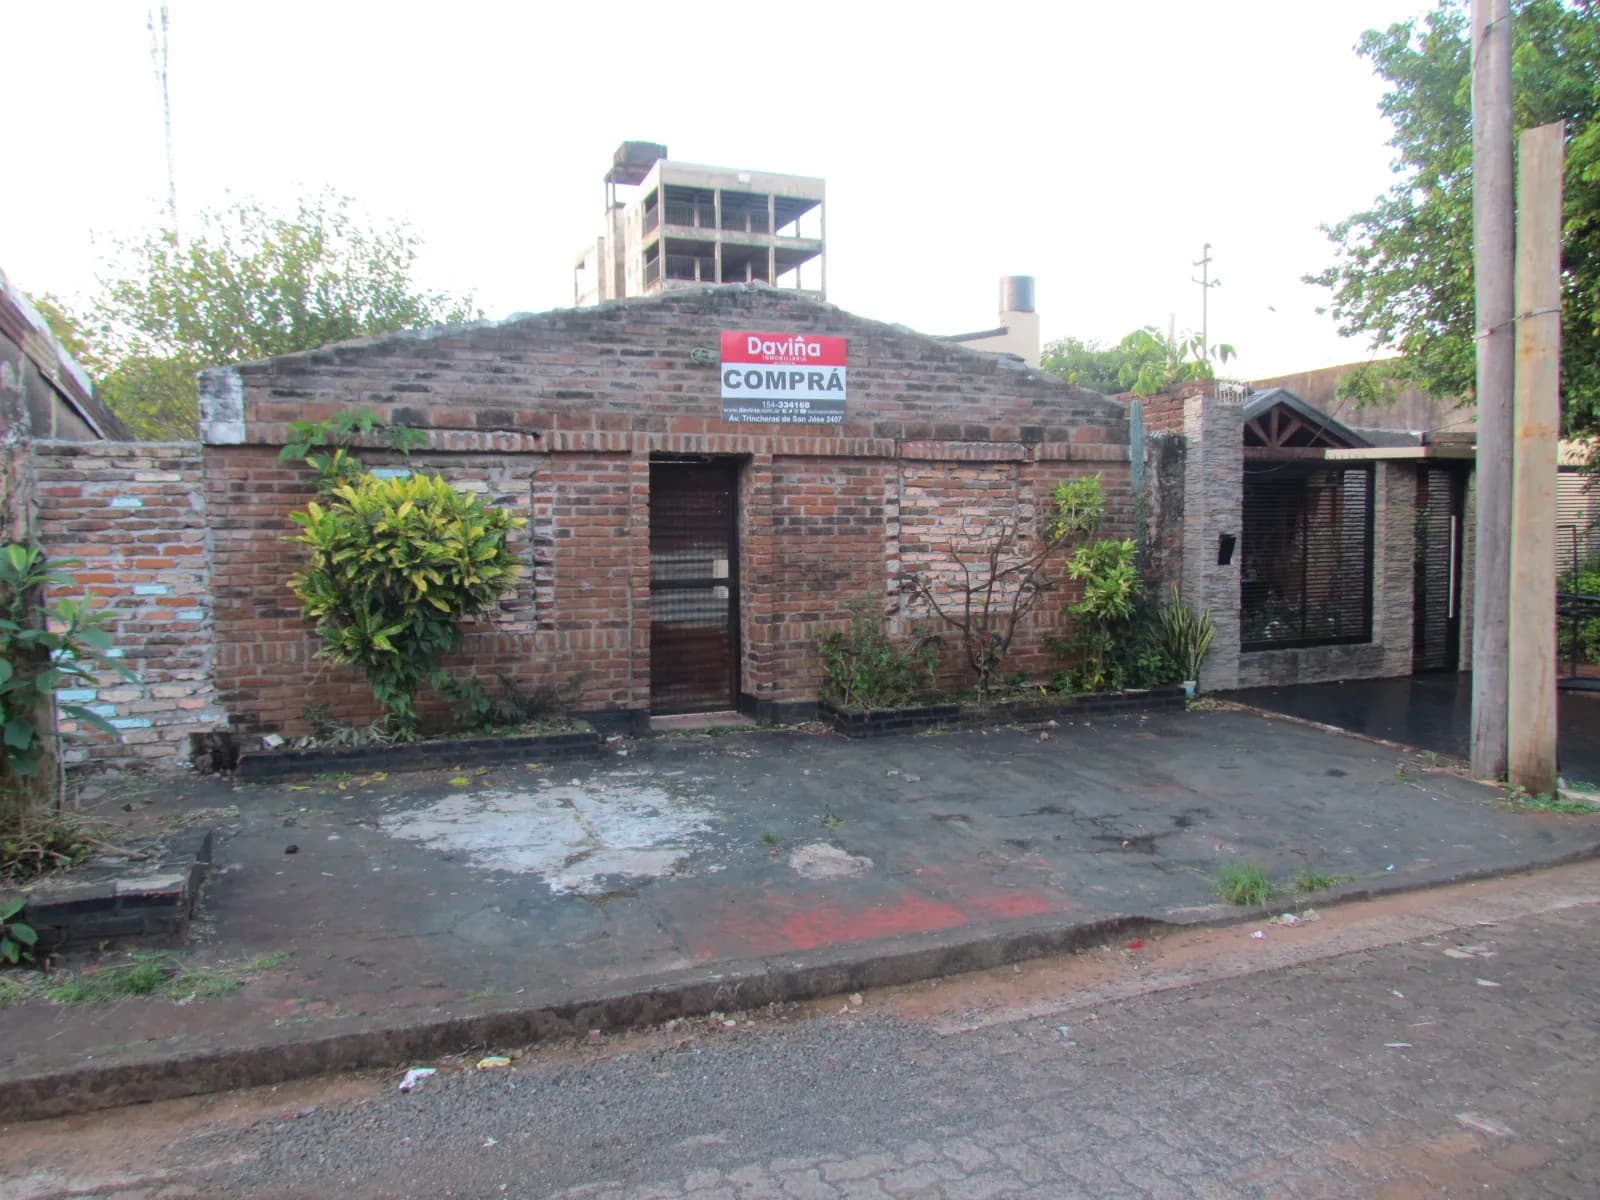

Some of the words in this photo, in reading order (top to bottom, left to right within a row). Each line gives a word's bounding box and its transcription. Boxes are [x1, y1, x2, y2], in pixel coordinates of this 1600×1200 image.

[723, 368, 844, 391] COMPRÁ
[781, 415, 791, 423] de
[792, 415, 806, 423] San
